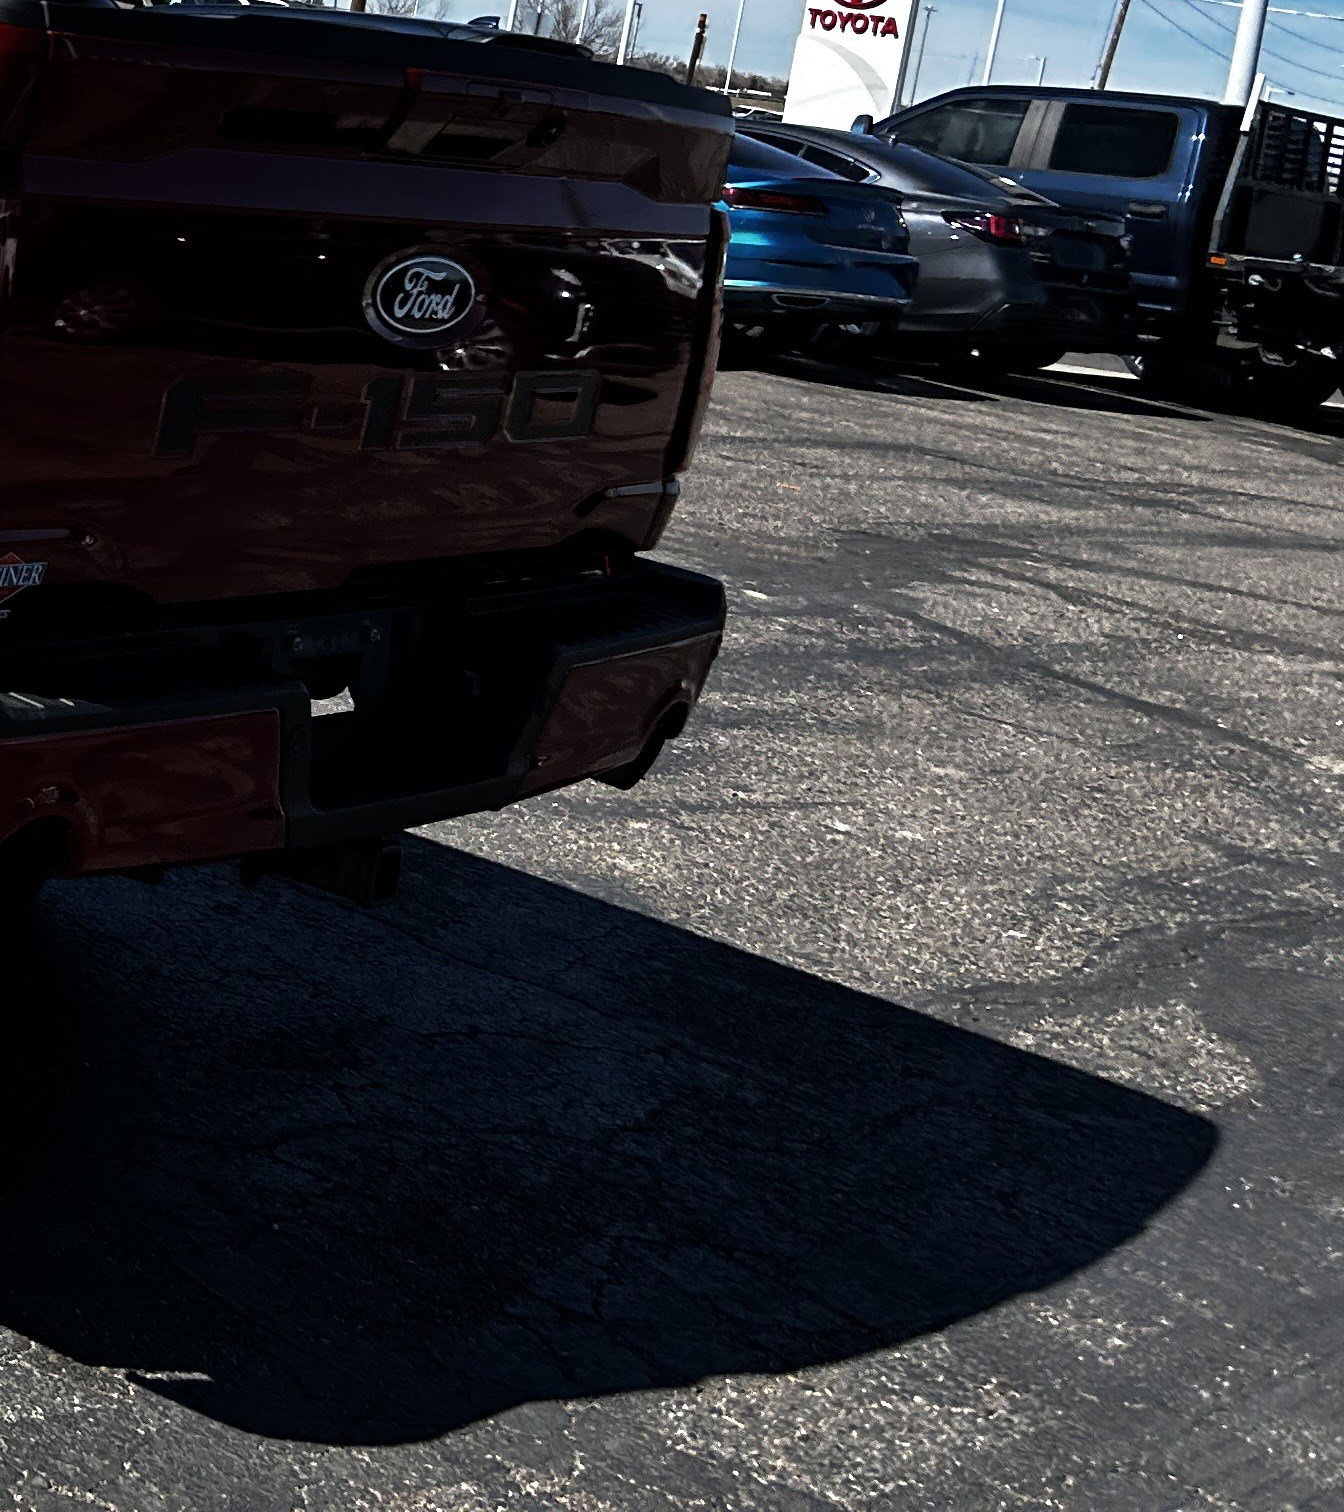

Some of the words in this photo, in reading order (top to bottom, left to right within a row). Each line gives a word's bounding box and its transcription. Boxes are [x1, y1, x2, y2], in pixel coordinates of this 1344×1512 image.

[808, 7, 899, 39] TOYOTA
[393, 266, 459, 320] Ford
[151, 368, 600, 459] F-150
